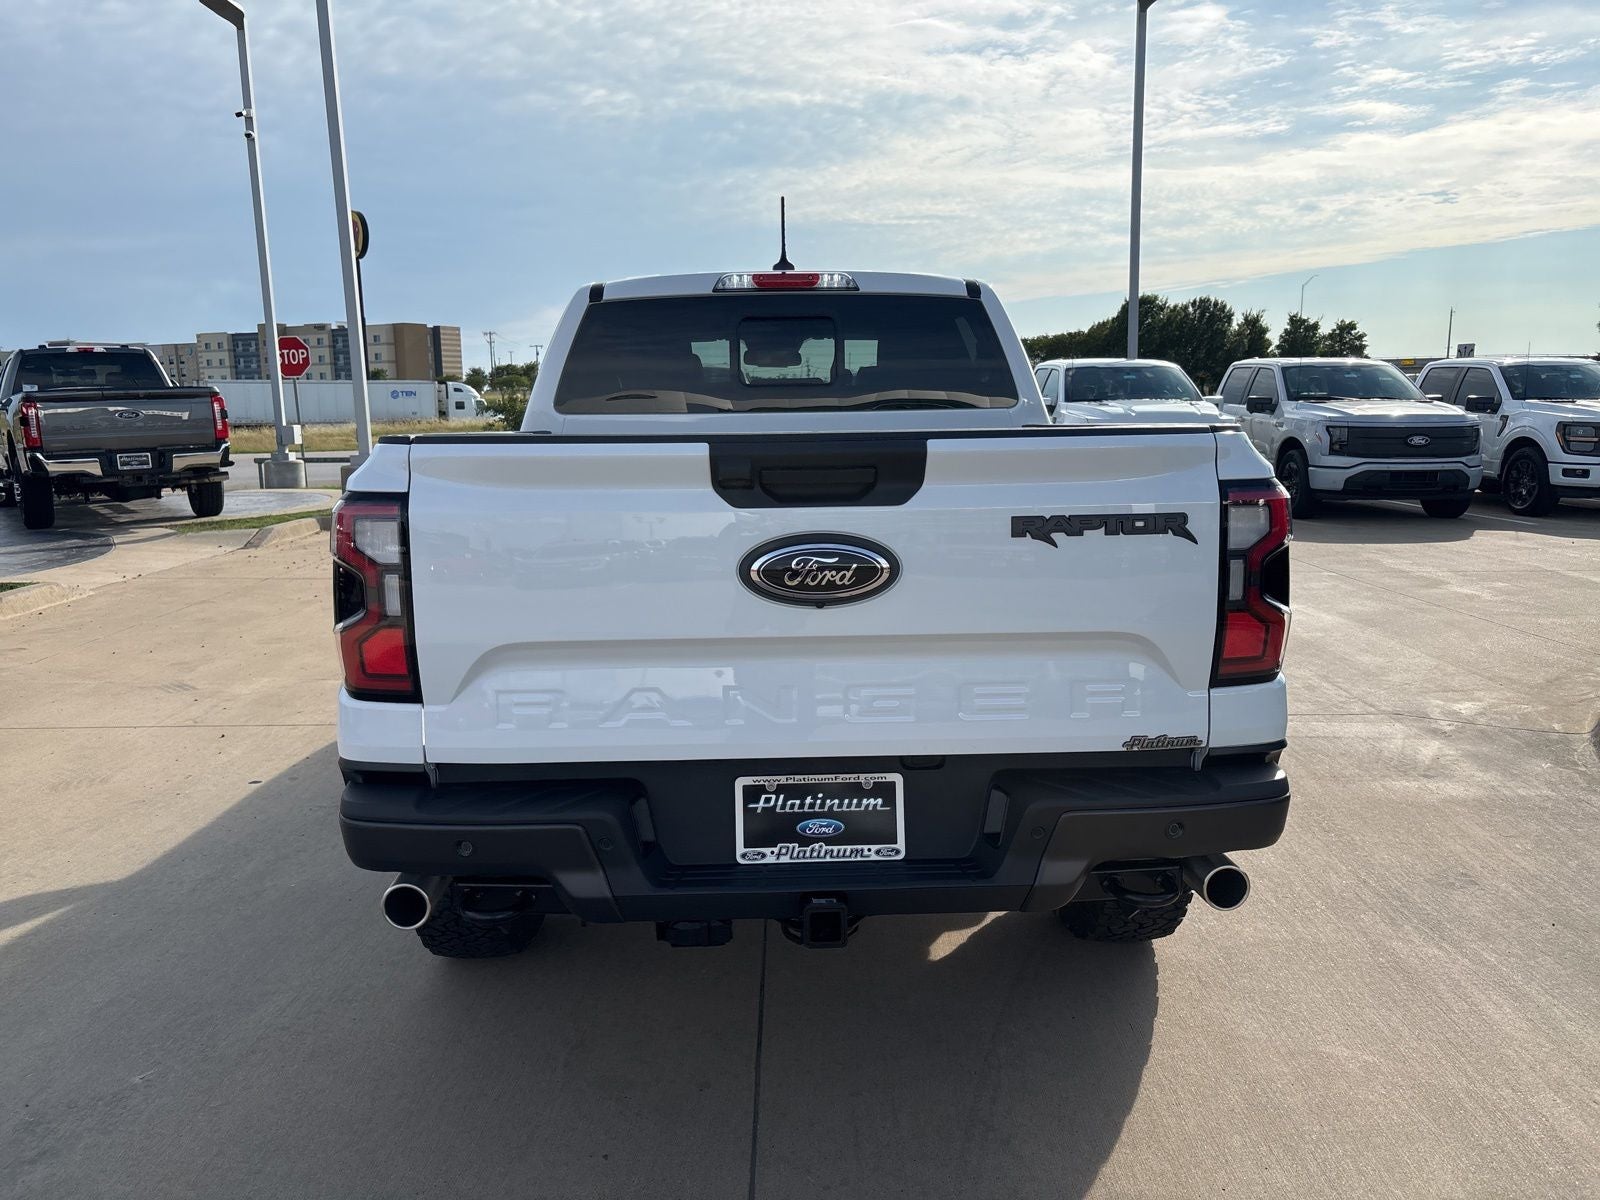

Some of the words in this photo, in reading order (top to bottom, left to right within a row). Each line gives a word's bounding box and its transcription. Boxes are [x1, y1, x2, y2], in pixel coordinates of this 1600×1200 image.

[1011, 512, 1198, 548] RAPTOR
[784, 556, 858, 586] Ford
[495, 680, 1142, 729] RANGER
[1122, 734, 1203, 751] Platinum
[752, 775, 887, 784] www.PlatinumFord.com
[747, 793, 891, 813] Platinum
[805, 820, 835, 834] Ford
[744, 852, 763, 861] Ford
[775, 842, 872, 861] Platinum
[878, 848, 897, 857] Ford
